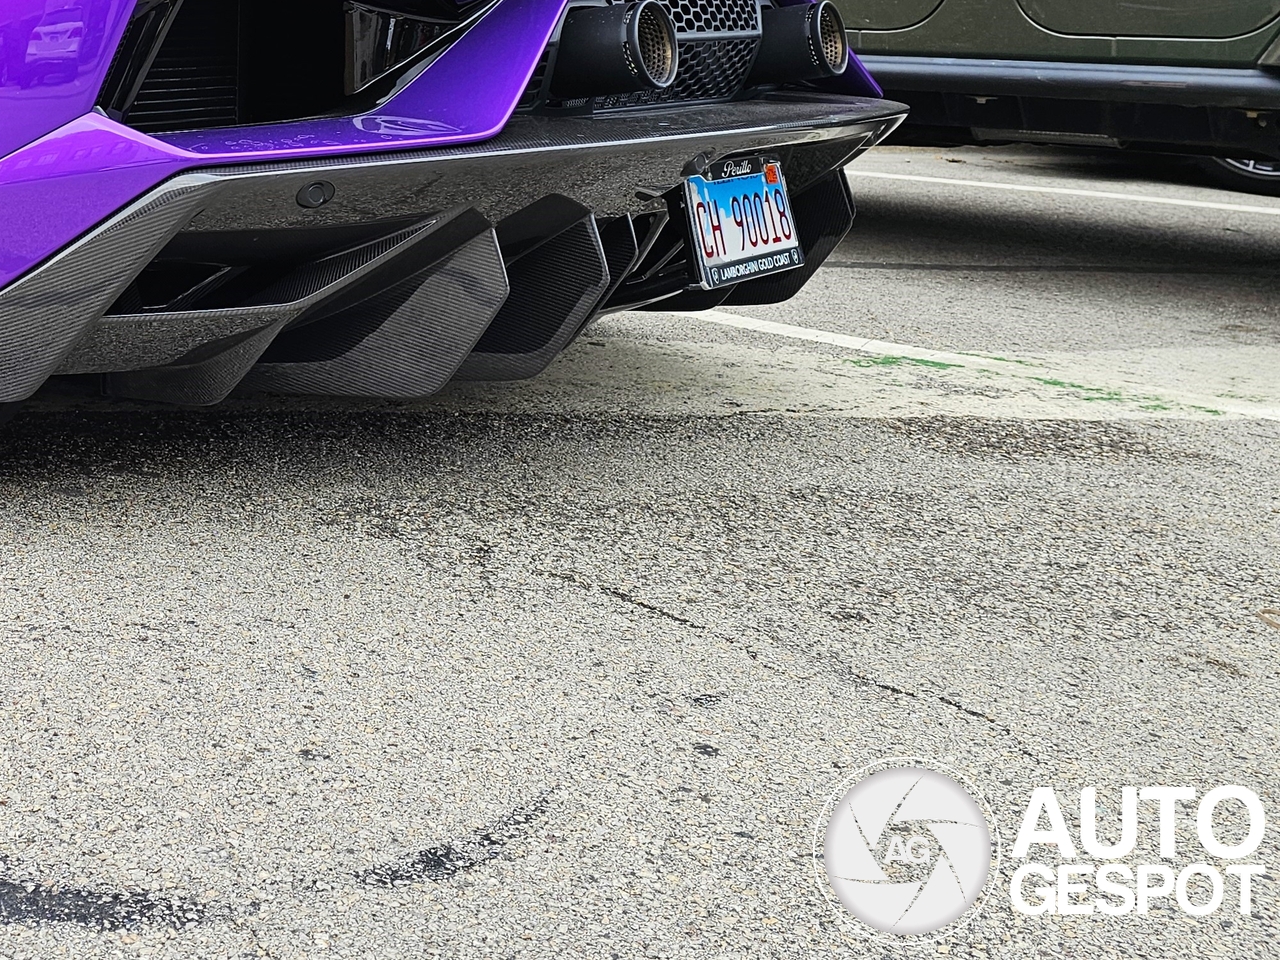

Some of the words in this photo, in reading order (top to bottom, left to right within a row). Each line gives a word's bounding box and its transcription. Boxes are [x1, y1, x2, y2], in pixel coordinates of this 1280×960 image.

[721, 159, 752, 178] Perillo
[695, 198, 727, 259] CH
[731, 187, 792, 252] 90018
[720, 260, 760, 280] LAMBORGHINI
[757, 257, 774, 271] GOLD
[773, 252, 791, 267] COAST
